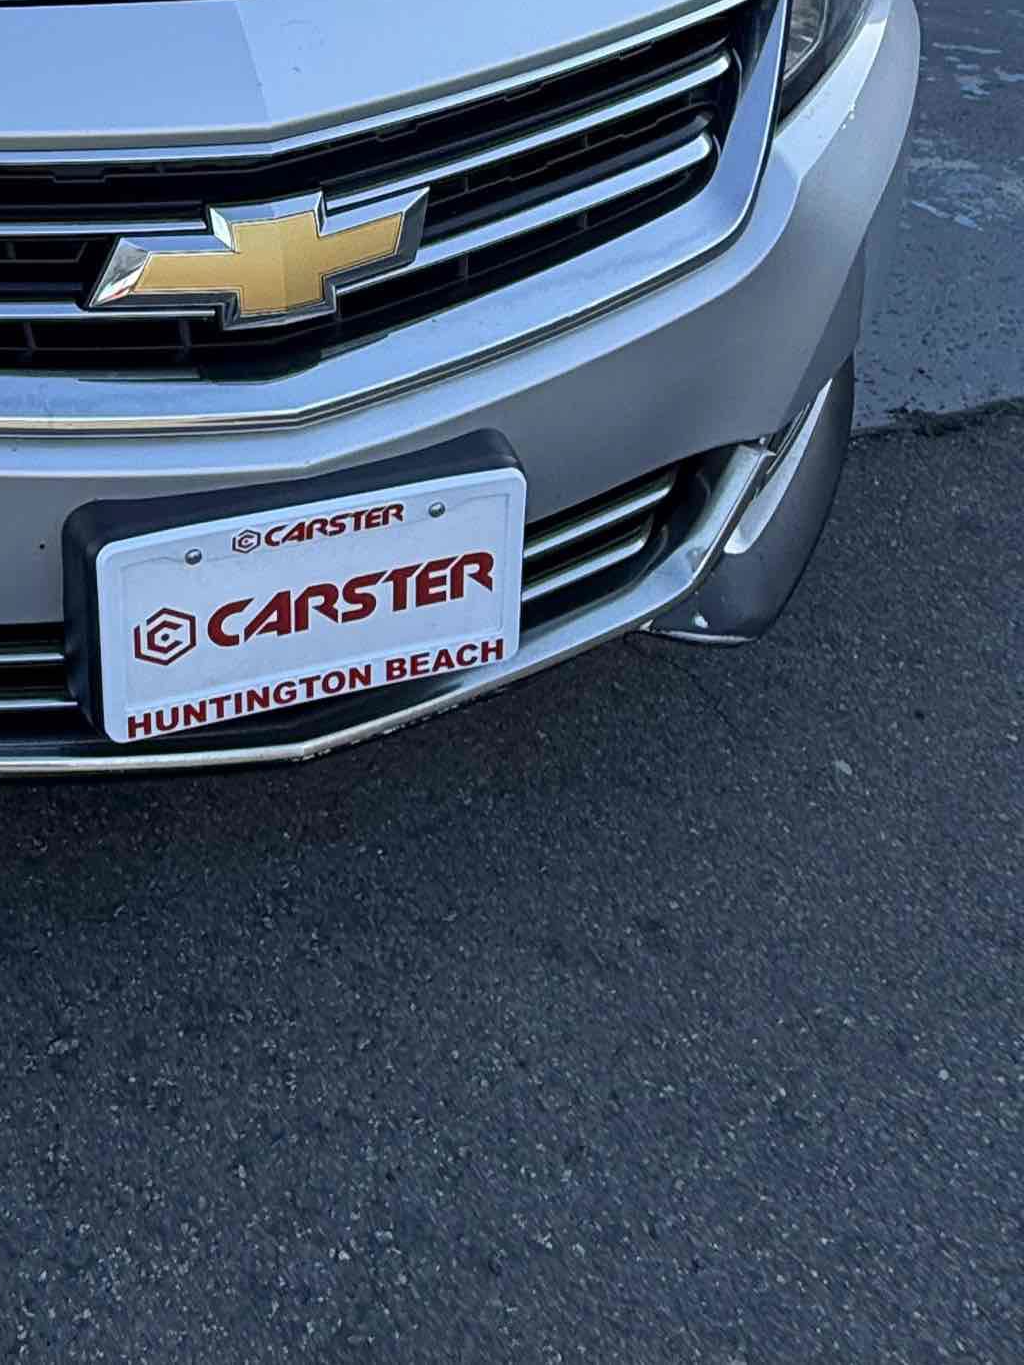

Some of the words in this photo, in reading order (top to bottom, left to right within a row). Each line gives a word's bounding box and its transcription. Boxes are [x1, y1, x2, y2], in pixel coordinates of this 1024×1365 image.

[264, 503, 405, 547] CARSTER
[207, 551, 495, 648] CARSTER
[127, 664, 373, 740] HUNTINGTON
[385, 638, 504, 683] BEACH
